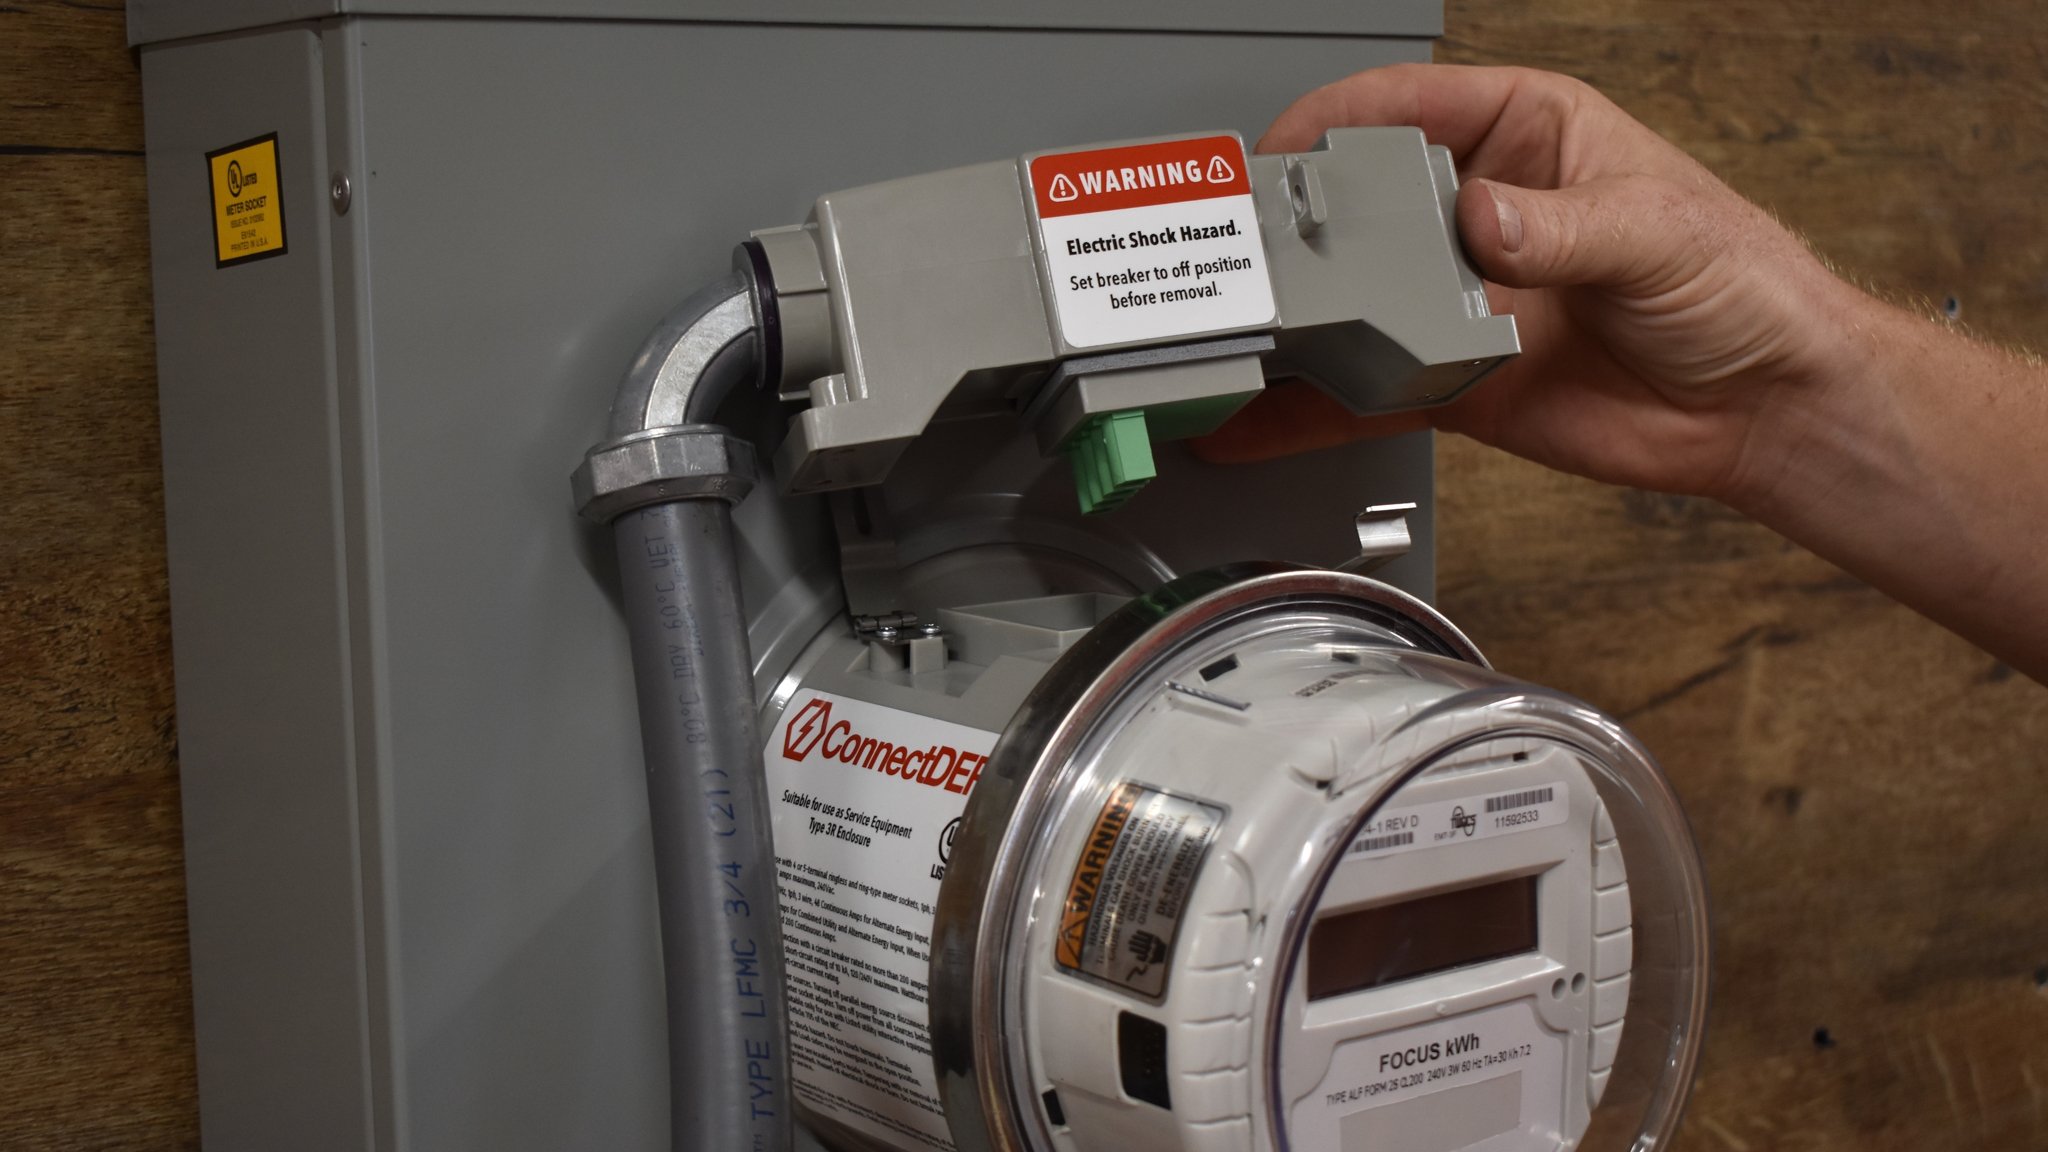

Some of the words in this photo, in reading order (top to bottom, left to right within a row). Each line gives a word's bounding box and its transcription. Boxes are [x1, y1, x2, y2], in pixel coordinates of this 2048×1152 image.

[1079, 160, 1202, 195] WARNING
[226, 202, 244, 216] METER
[245, 196, 267, 212] SOCKET
[1066, 234, 1126, 255] Electric
[1128, 228, 1177, 248] Shock
[1180, 219, 1241, 242] Hazard.
[1070, 275, 1093, 291] Set
[1096, 268, 1150, 288] breaker
[1154, 266, 1168, 280] to
[1172, 261, 1190, 278] off
[1194, 257, 1251, 280] position
[1110, 291, 1156, 309] before
[1160, 281, 1222, 303] removal.
[656, 581, 684, 629] 60°C
[668, 645, 695, 680] DRY
[702, 769, 736, 836] (21)
[782, 789, 811, 809] Suitable
[811, 797, 822, 811] for
[822, 805, 835, 816] use
[835, 808, 843, 819] as
[843, 808, 870, 827] Service
[871, 815, 912, 839] Equipment
[1495, 810, 1539, 828] 11592533
[808, 817, 825, 836] Type
[825, 822, 836, 836] 3R
[836, 826, 871, 847] Enclosure
[1361, 820, 1383, 837] 4-1
[1385, 817, 1408, 832] REV
[1410, 814, 1419, 828] D
[718, 862, 749, 917] 3/4
[1088, 883, 1110, 946] HAZARDOUS
[1107, 832, 1132, 881] VOLTAGES
[1127, 816, 1140, 832] ON
[1110, 882, 1123, 904] CAN
[1118, 848, 1137, 882] SHOCK
[1127, 893, 1141, 921] ONLY
[1141, 831, 1168, 878] REMOVED
[731, 938, 766, 1017] LFMC
[1379, 1042, 1439, 1072] FOCUS
[1446, 1033, 1479, 1057] kWh
[746, 1039, 775, 1120] TYPE
[1326, 1091, 1346, 1105] TYPE
[1364, 1081, 1388, 1098] FORM
[1427, 1066, 1447, 1083] 240V
[1448, 1062, 1461, 1078] 3W
[1461, 1059, 1471, 1073] 60
[1472, 1057, 1482, 1071] Hz
